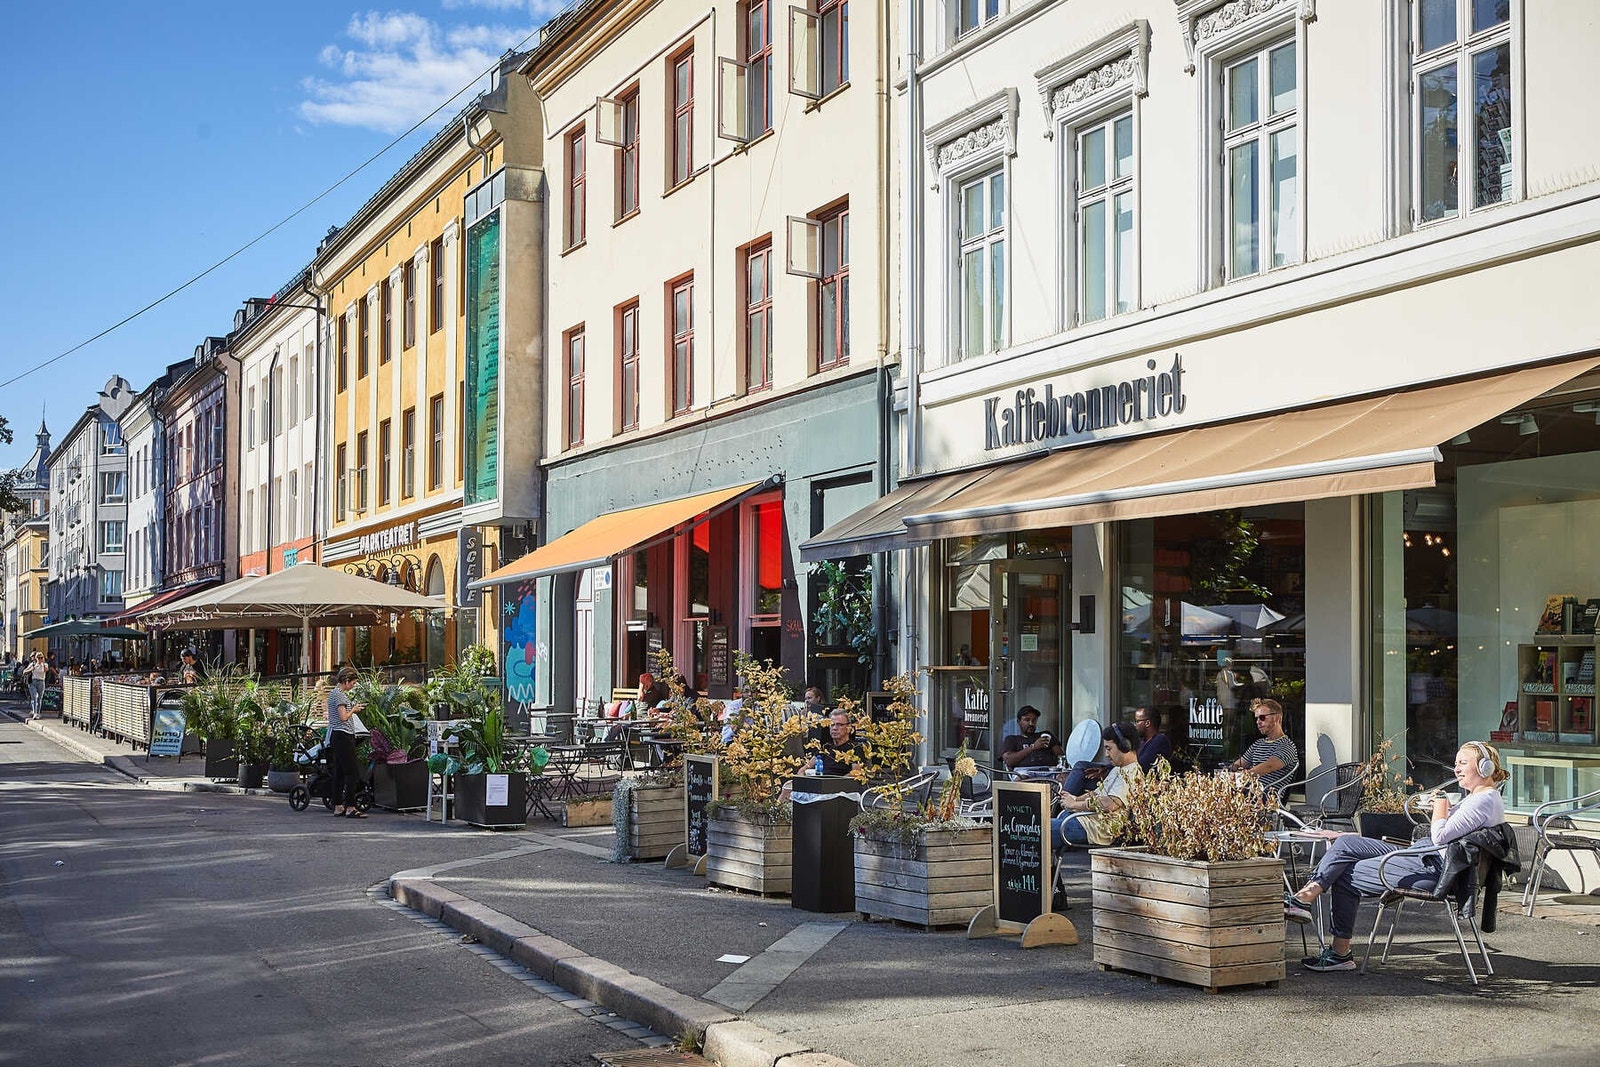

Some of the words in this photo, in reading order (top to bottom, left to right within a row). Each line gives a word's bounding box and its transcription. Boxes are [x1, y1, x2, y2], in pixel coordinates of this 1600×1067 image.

[984, 353, 1186, 451] Kaffebrenneriet
[359, 521, 415, 555] PARKTEATRET
[964, 687, 989, 711] Kaffe
[1189, 697, 1224, 725] Kaffe
[1188, 724, 1224, 740] brenneriet
